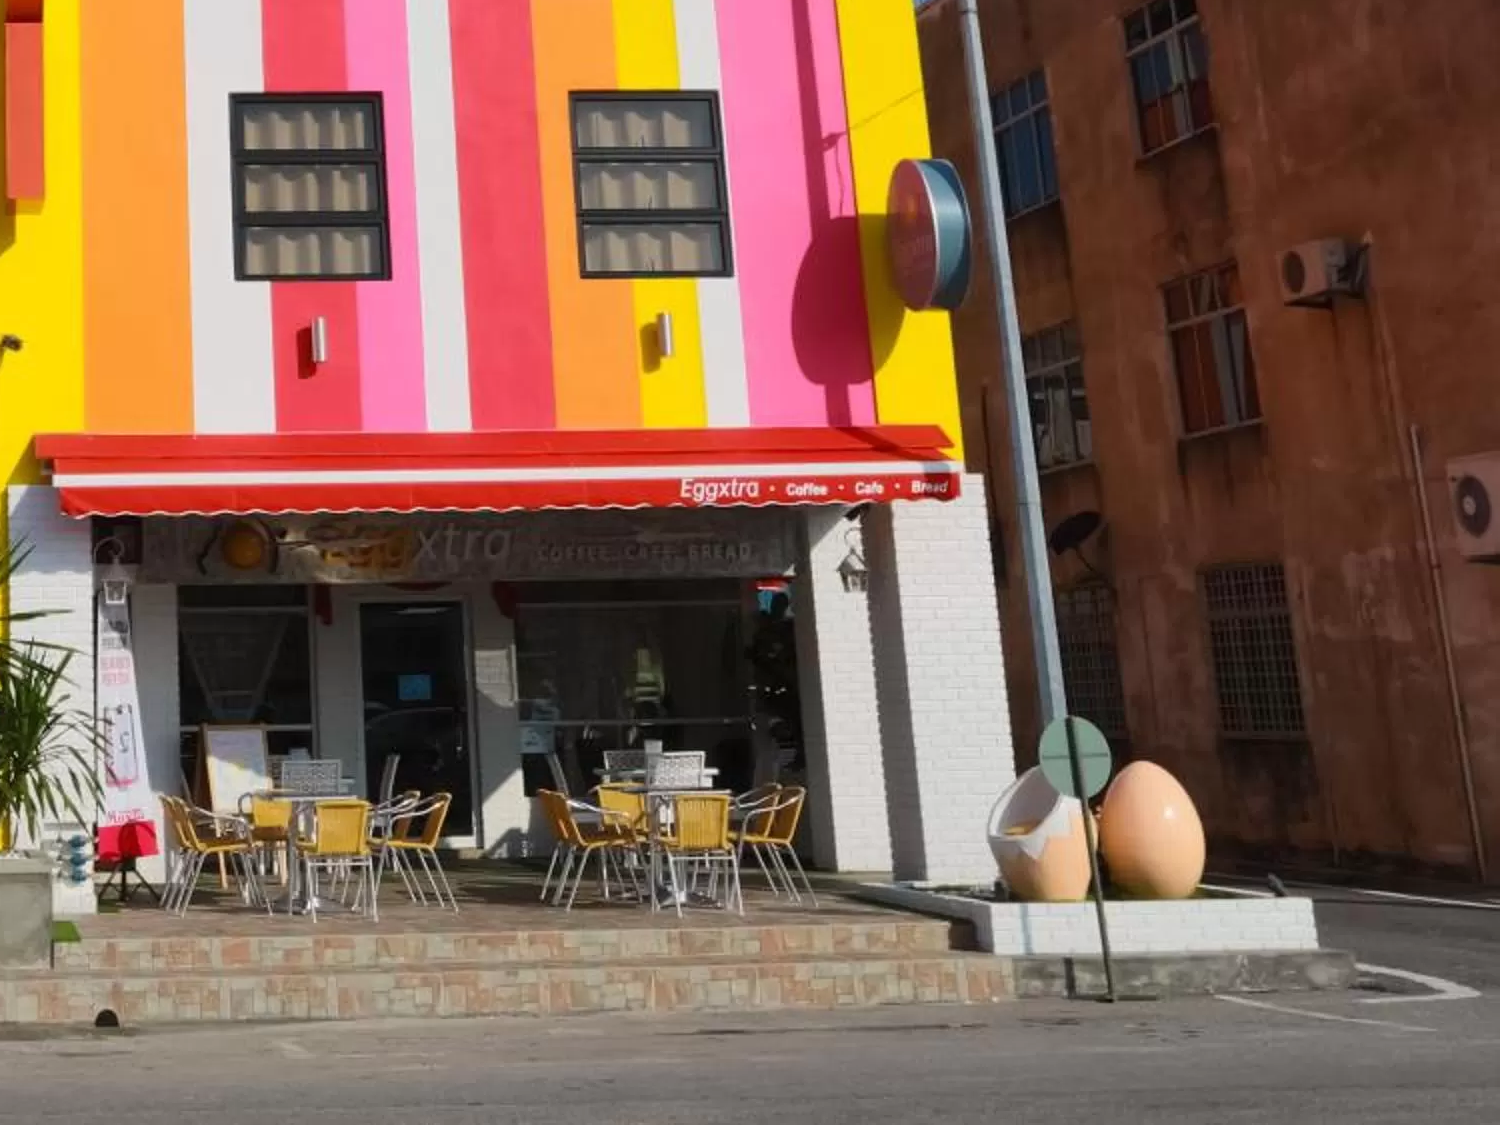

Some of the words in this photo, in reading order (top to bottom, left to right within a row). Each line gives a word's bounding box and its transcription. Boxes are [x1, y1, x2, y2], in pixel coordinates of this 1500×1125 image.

[680, 478, 759, 502] Eggxtra
[785, 482, 828, 496] Coffee
[911, 480, 949, 494] Bread
